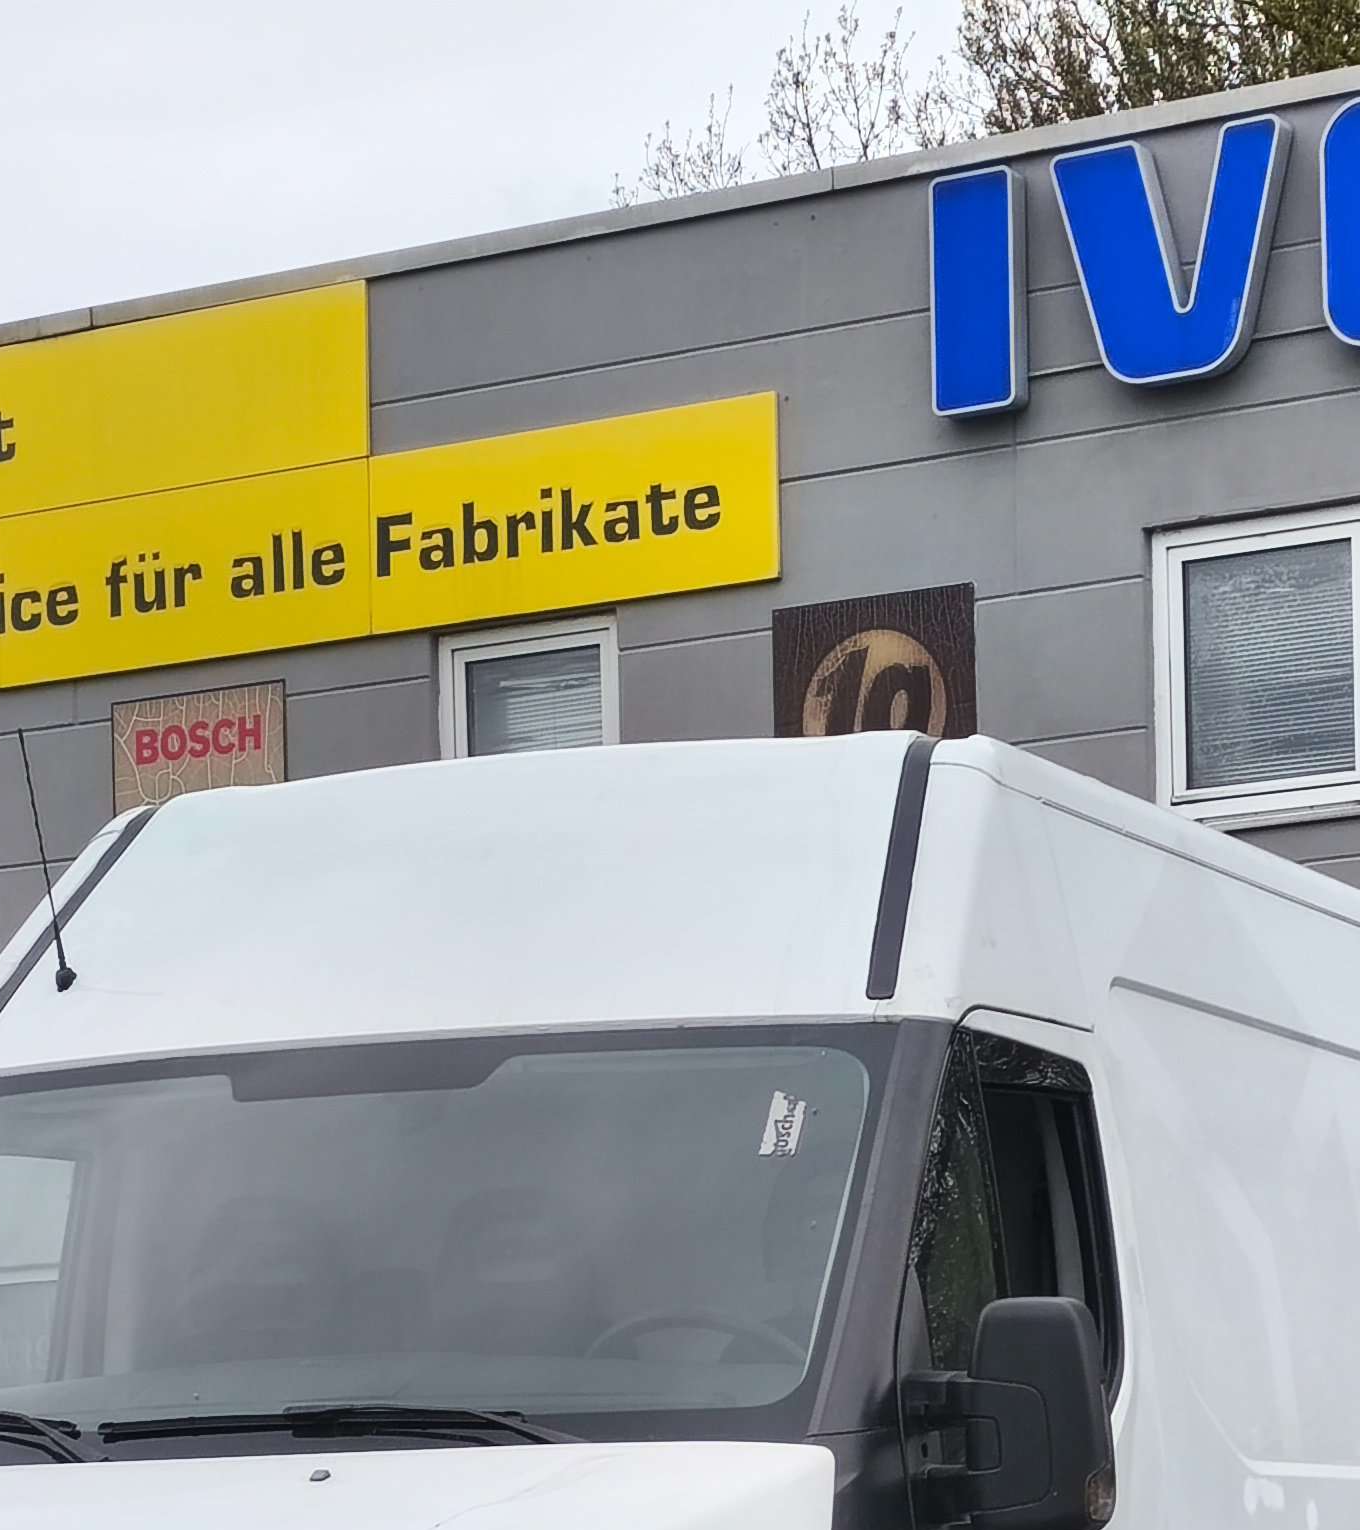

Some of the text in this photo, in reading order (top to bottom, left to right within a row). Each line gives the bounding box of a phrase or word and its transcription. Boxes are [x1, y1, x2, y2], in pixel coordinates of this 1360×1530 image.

[105, 553, 202, 617] für
[230, 528, 346, 600] alle
[375, 482, 722, 578] Fabrikate
[134, 714, 264, 767] BOSCH
